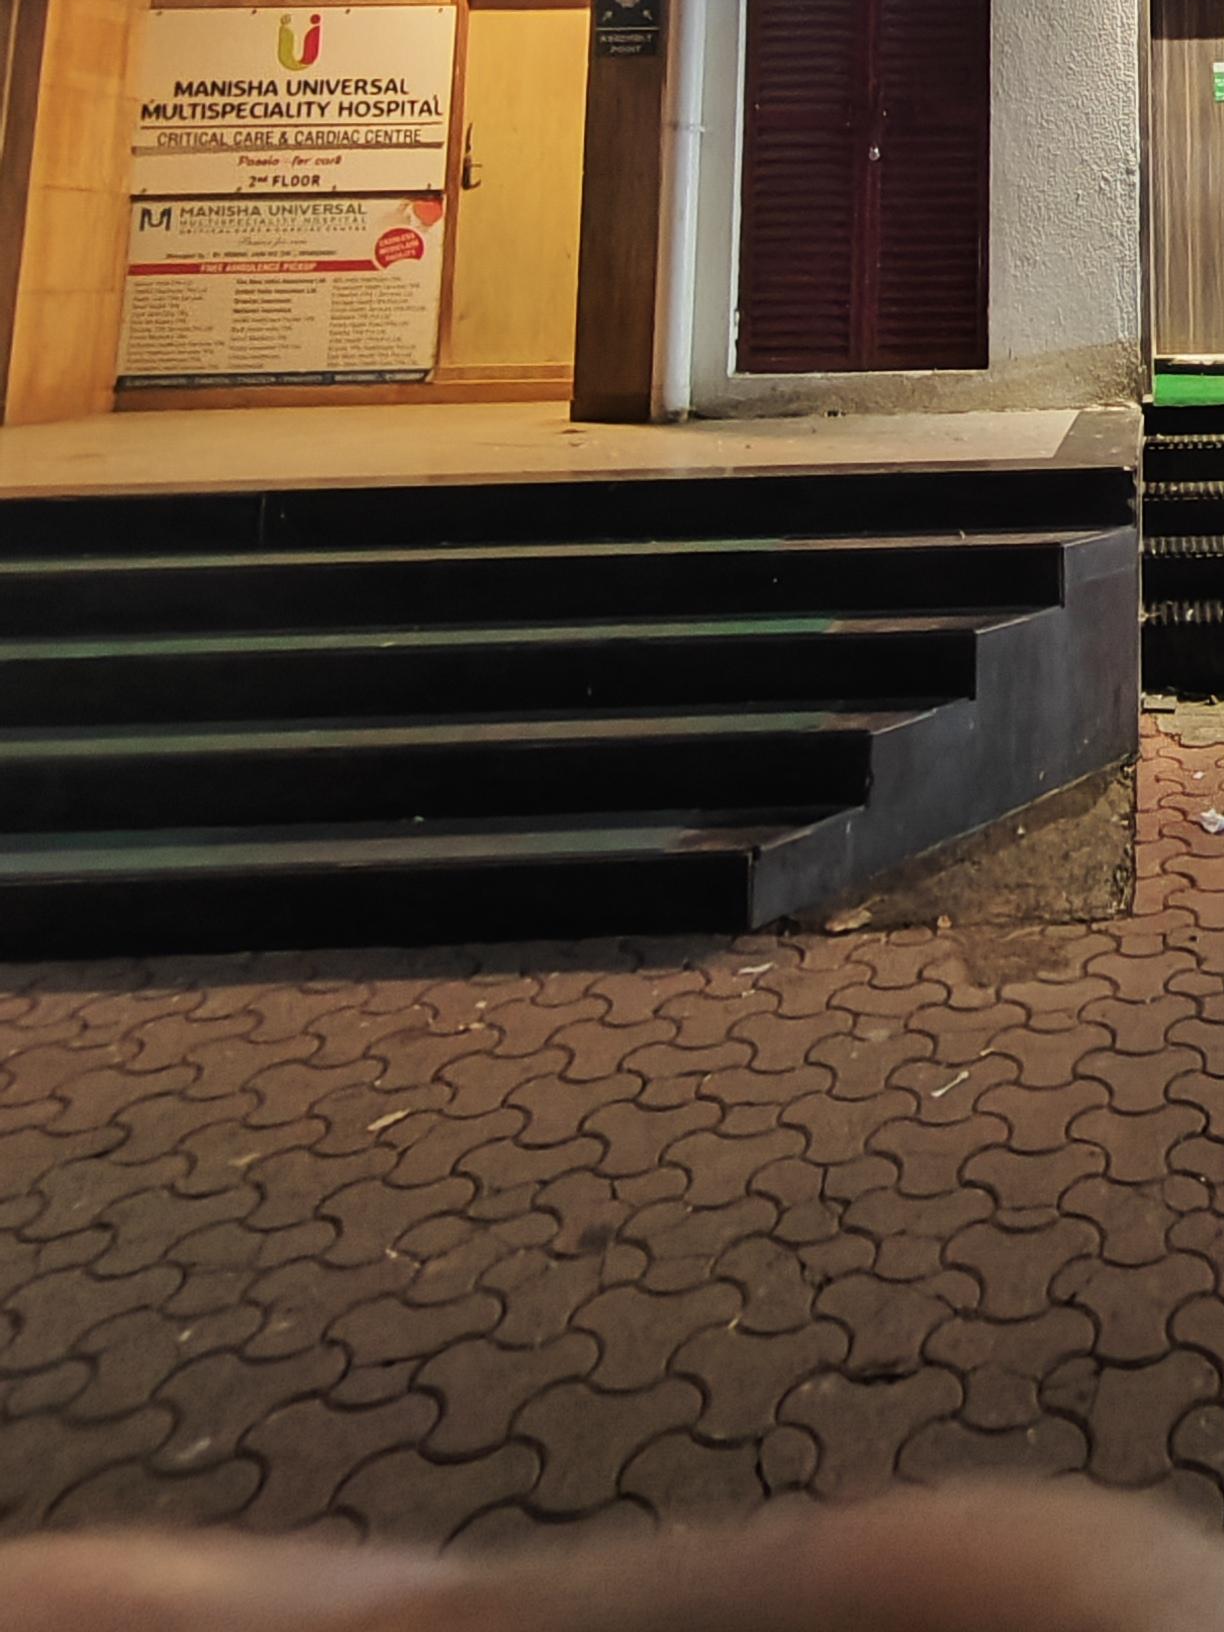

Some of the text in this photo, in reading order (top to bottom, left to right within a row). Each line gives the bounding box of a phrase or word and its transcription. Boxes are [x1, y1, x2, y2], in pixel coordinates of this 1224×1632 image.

[174, 78, 410, 97] MANISHA UNIVERSAL
[140, 98, 444, 120] MULTISPECIALITY HOSPITAL
[157, 128, 422, 148] CRITICAL CARE & CARDIAC CENTRE
[248, 174, 321, 188] 2nd FLOOR
[179, 202, 368, 218] MANISHA UNIVERSAL
